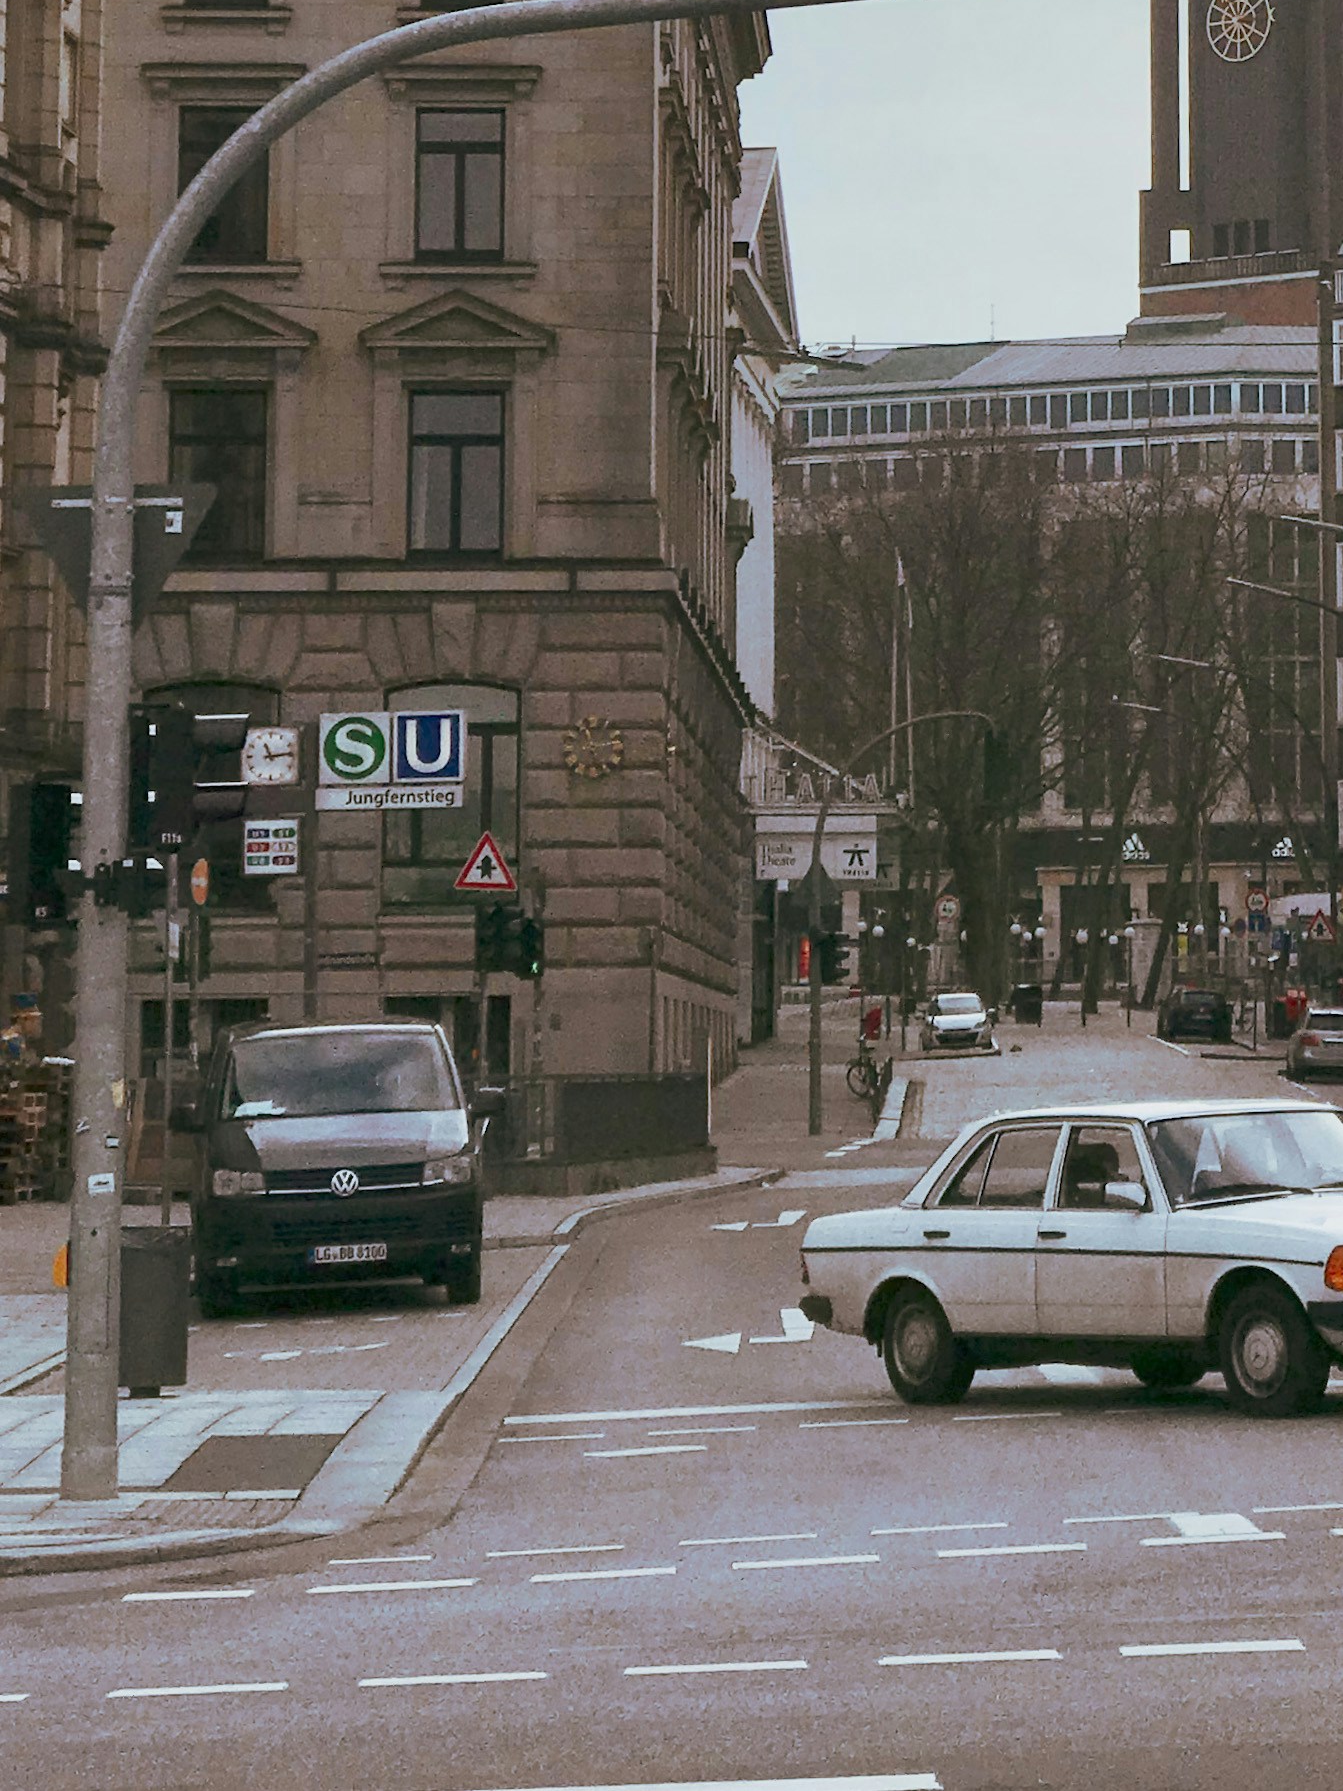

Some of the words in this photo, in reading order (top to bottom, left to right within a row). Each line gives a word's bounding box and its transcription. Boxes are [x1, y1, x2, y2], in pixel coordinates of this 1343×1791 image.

[334, 722, 376, 775] S
[405, 718, 452, 774] U
[345, 789, 456, 808] Jungfernstieg
